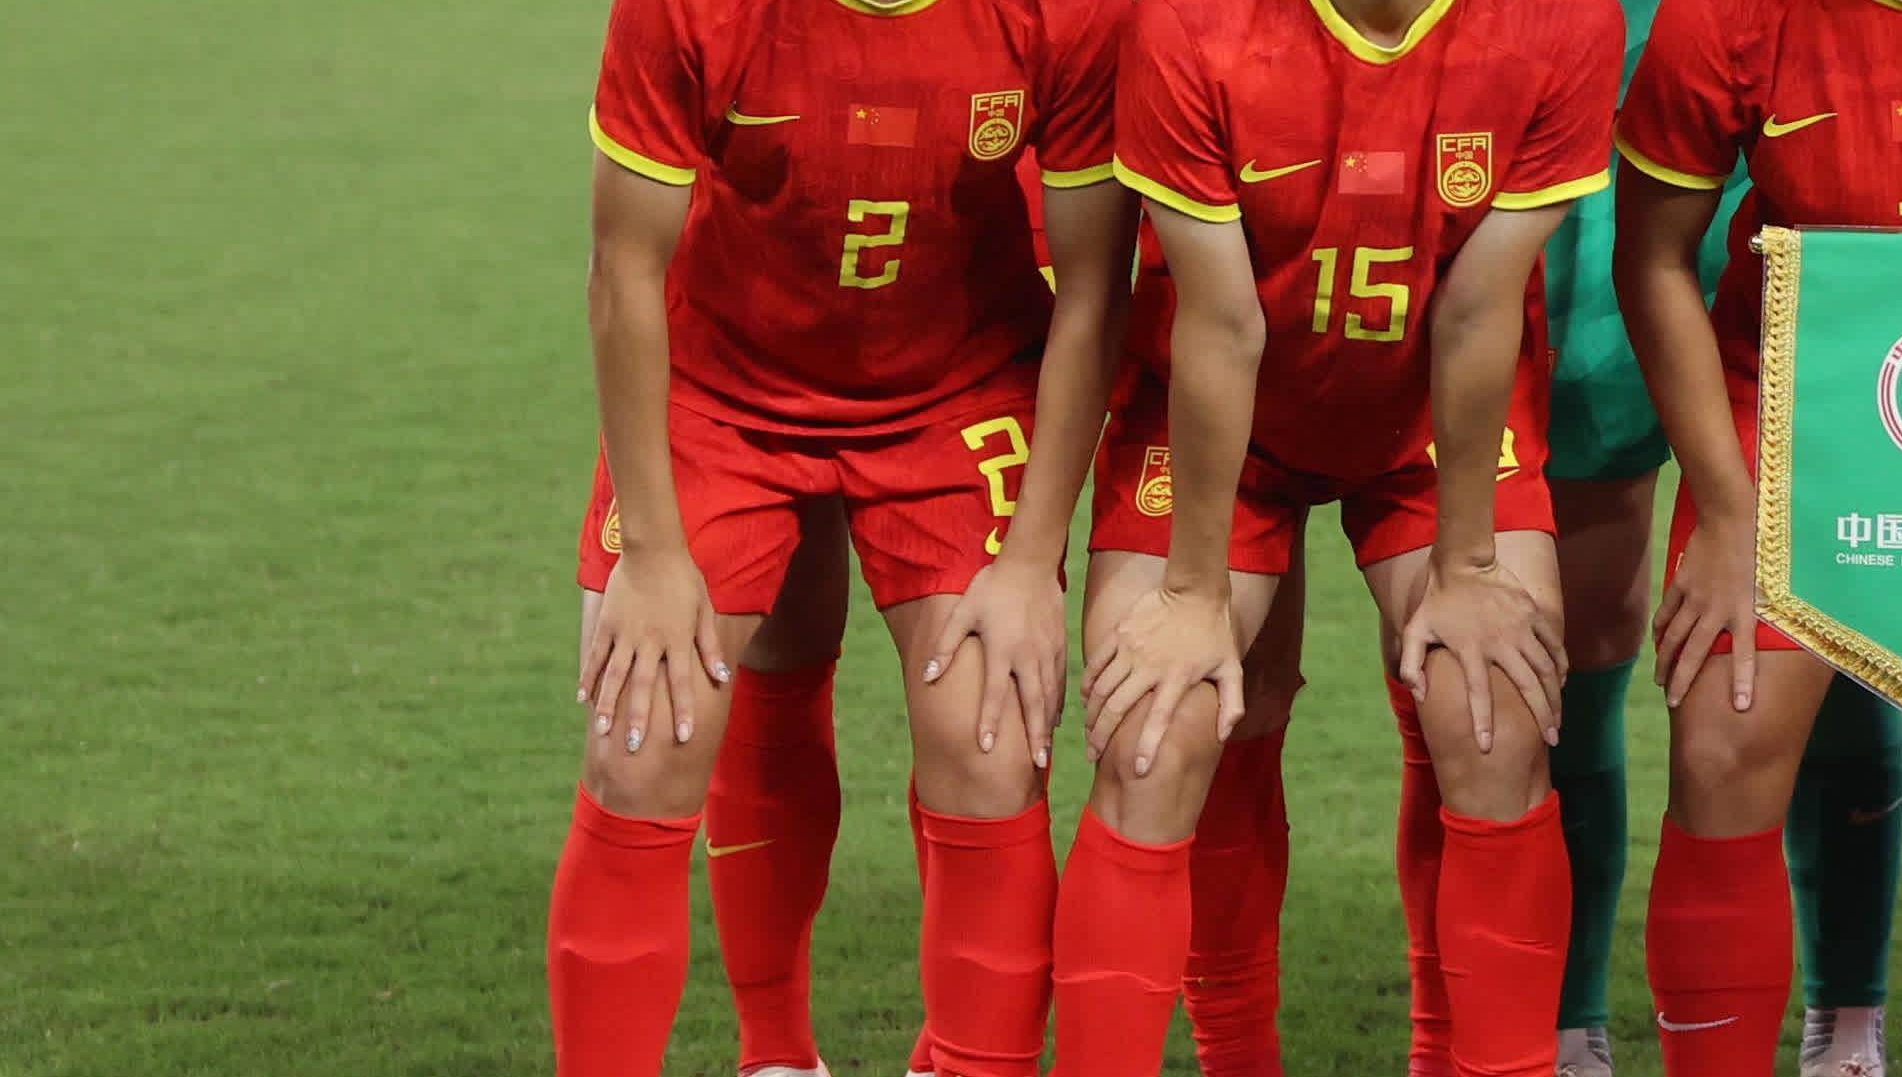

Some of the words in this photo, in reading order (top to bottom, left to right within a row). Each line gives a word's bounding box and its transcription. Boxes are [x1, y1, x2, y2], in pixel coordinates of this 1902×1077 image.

[976, 95, 1019, 112] CFA
[1442, 137, 1487, 153] CFA
[838, 199, 911, 289] 2
[1312, 246, 1414, 342] 15
[960, 415, 1030, 517] 2
[1836, 553, 1895, 567] CHINESE
